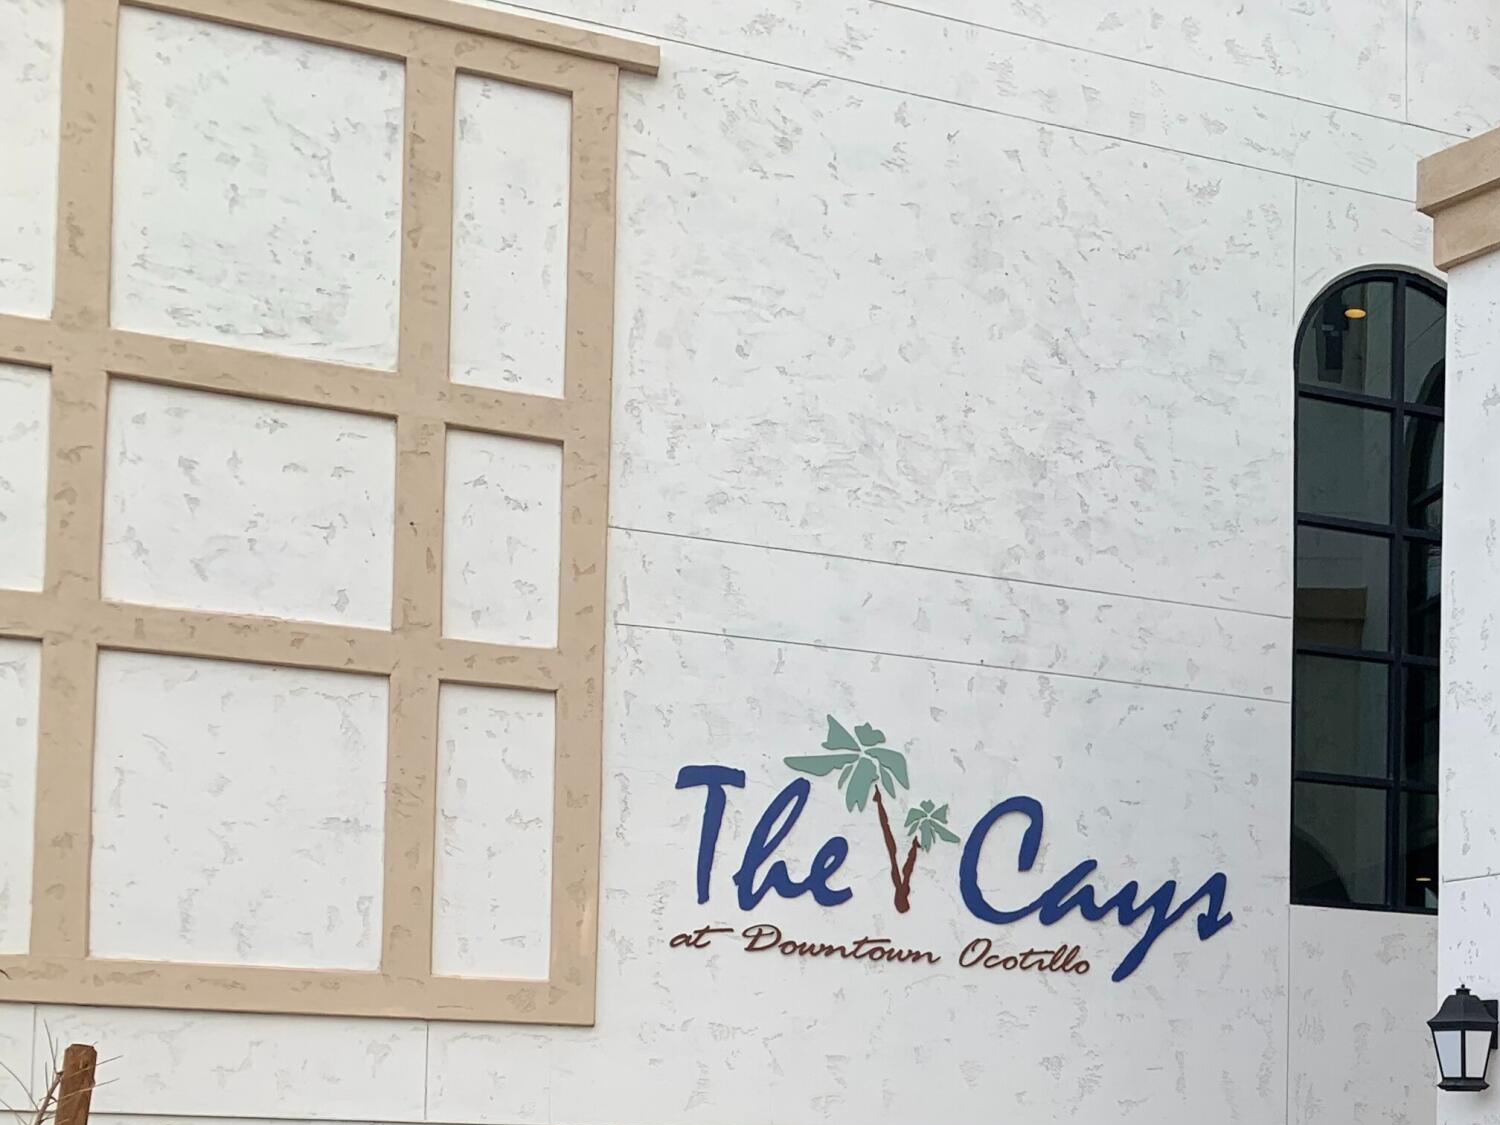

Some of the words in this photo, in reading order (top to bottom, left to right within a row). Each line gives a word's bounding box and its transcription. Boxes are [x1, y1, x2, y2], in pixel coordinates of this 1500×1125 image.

[674, 765, 854, 911] The
[958, 795, 1233, 982] Cays
[669, 925, 735, 949] at
[741, 923, 941, 965] Downtown
[957, 938, 1091, 975] Ocotillo
